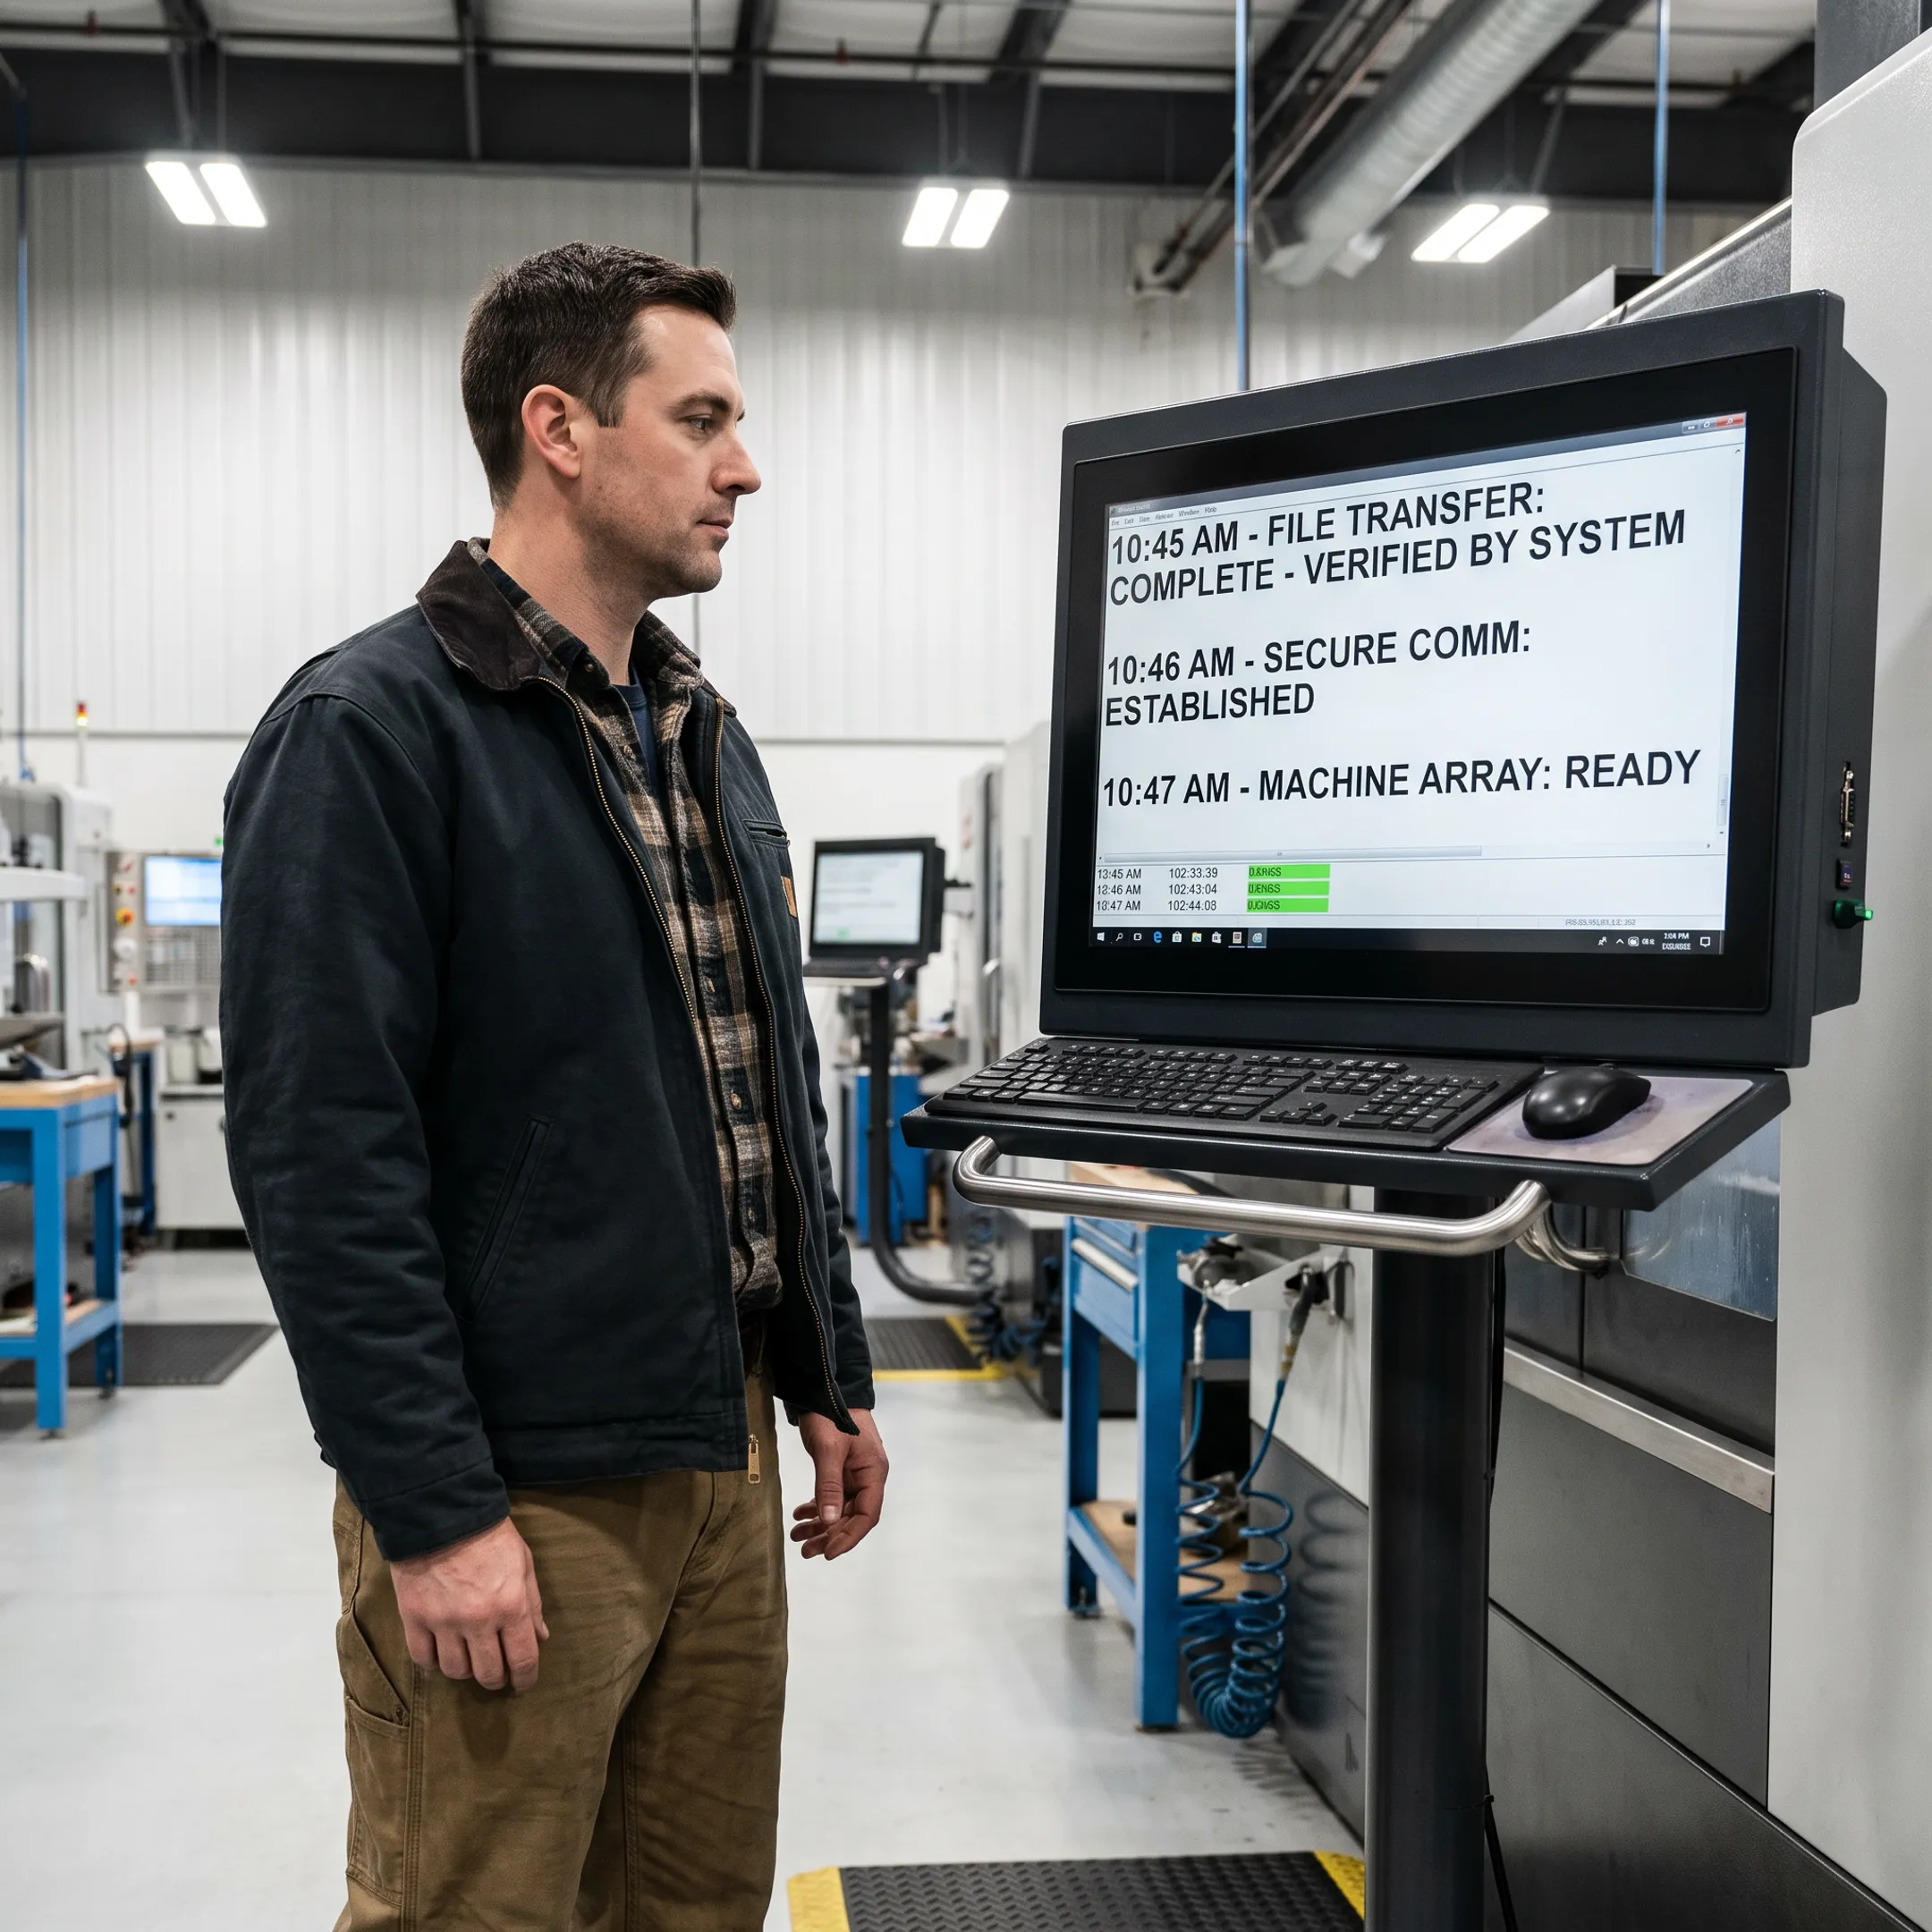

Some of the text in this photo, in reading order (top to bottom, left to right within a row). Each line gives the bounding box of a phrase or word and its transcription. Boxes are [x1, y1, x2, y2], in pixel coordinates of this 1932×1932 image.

[1112, 482, 1544, 565] 10:45 AM - FILE TRANSFER:
[1110, 509, 1685, 606] COMPLETE - VERIFIED BY SYSTEM
[1108, 652, 1181, 685] 10:46
[1187, 646, 1234, 680] AM
[1264, 631, 1397, 674] SECURE
[1408, 620, 1530, 664] COMM:
[1106, 682, 1315, 727] ESTABLISHED
[1103, 749, 1701, 807] 10:47 AM - MACHINE ARRAY: READY
[1125, 885, 1141, 895] AM
[1126, 869, 1142, 879] AM
[1124, 900, 1140, 911] AM
